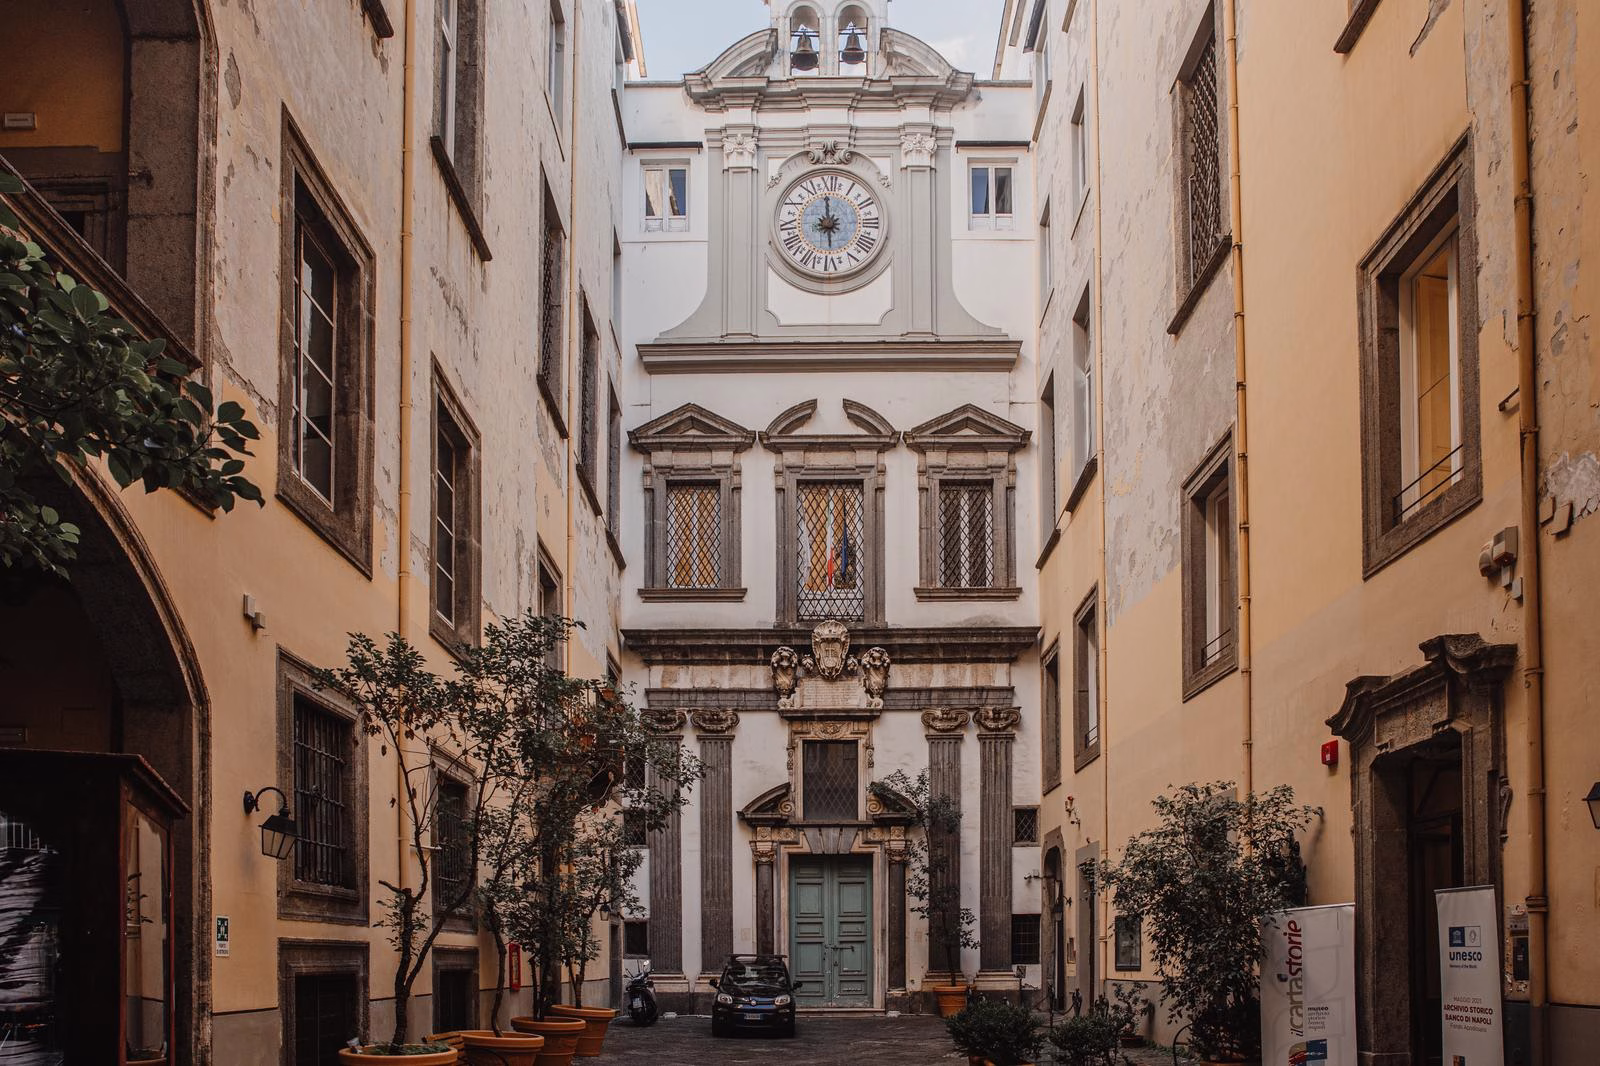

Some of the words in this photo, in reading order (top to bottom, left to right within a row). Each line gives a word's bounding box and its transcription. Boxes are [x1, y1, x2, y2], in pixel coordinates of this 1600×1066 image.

[822, 176, 838, 192] XII
[857, 197, 874, 210] II
[862, 217, 879, 229] III
[1449, 951, 1482, 962] unesco
[1444, 1004, 1468, 1013] ARCHIVIO
[1469, 1006, 1493, 1015] STORICO
[1445, 1013, 1464, 1022] BANCO
[1472, 1017, 1492, 1025] NAPOLI
